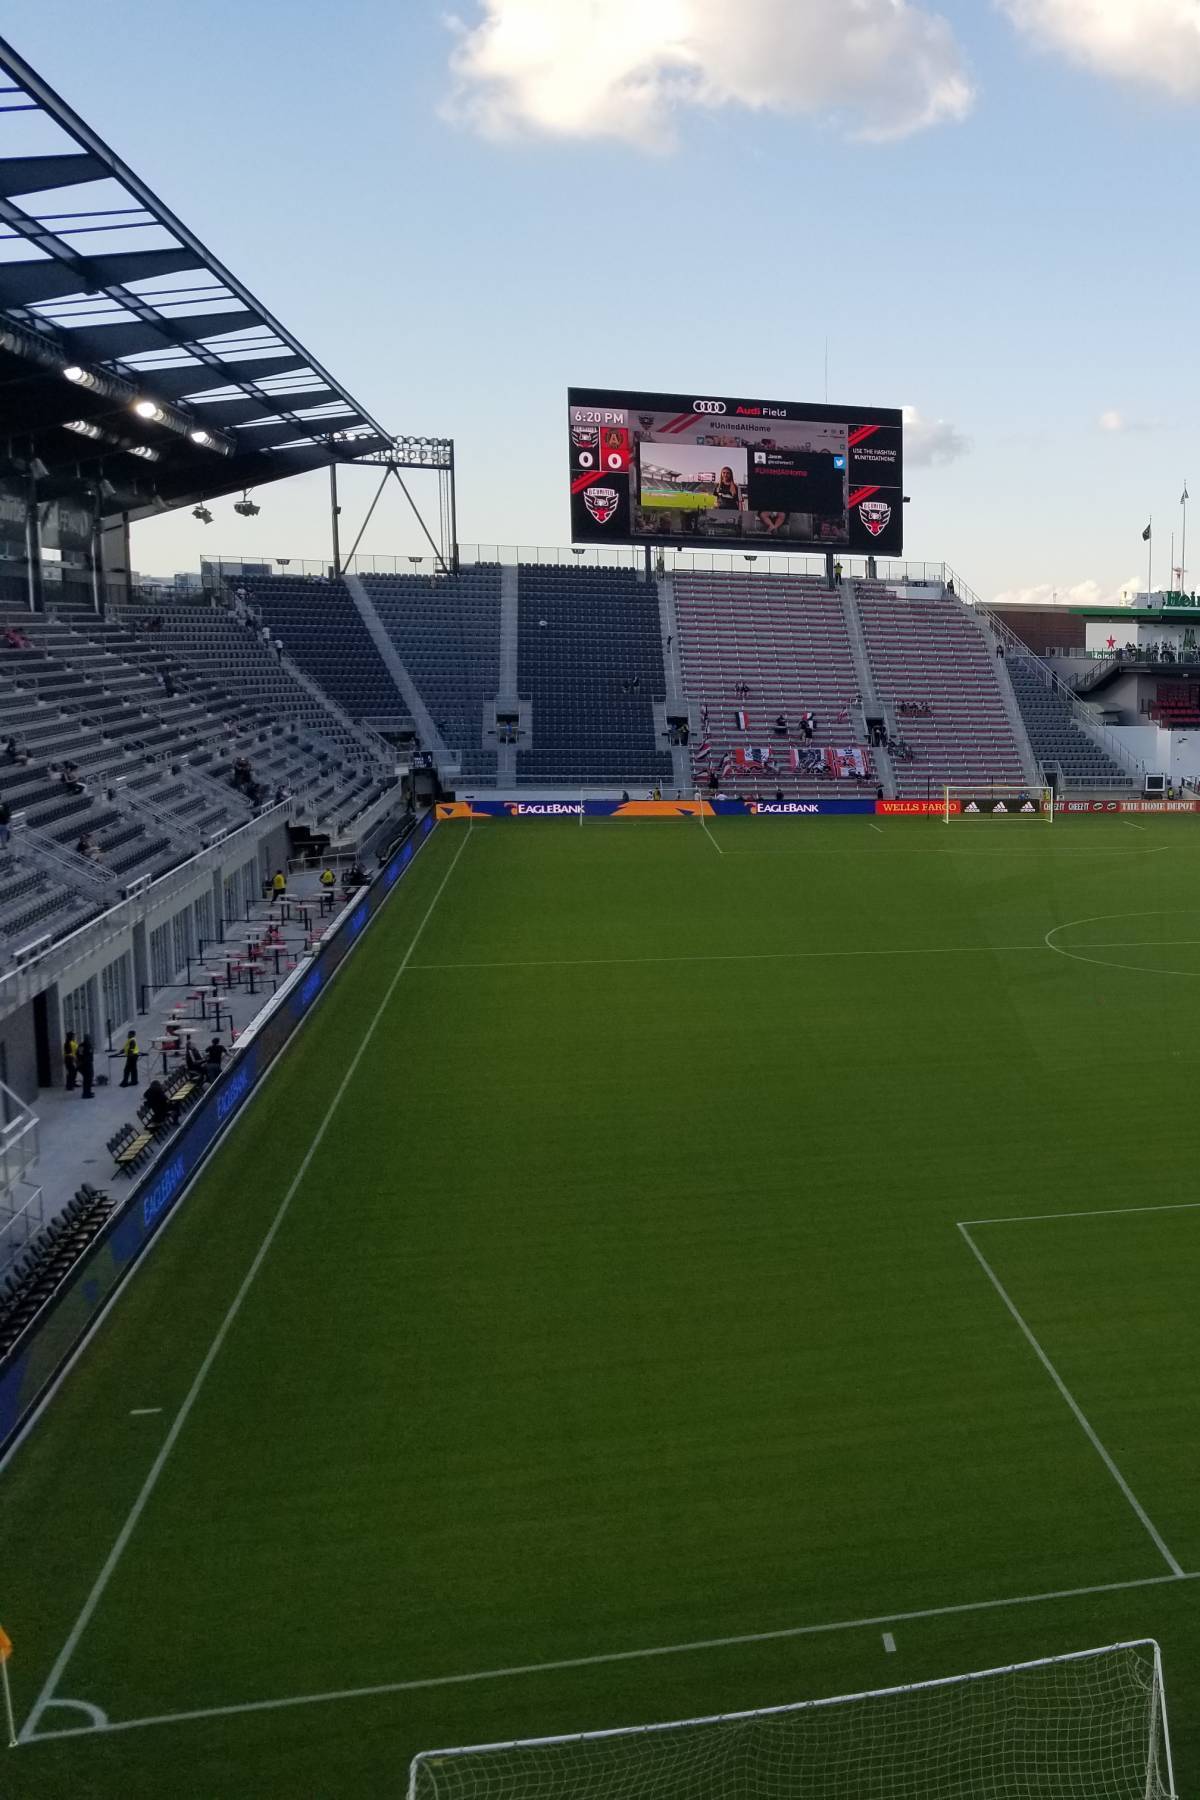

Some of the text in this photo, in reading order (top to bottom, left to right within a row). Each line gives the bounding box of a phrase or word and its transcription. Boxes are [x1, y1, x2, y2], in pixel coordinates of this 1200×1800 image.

[736, 406, 787, 417] Audi Field
[575, 411, 624, 424] 6:20 PM
[710, 422, 772, 433] #UnitedAtHome
[864, 448, 874, 456] THE
[579, 451, 593, 468] 0
[608, 453, 622, 469] 0
[883, 803, 920, 811] WELLS
[922, 803, 957, 812] FARGO
[1121, 802, 1194, 811] THE HOME DEPOT
